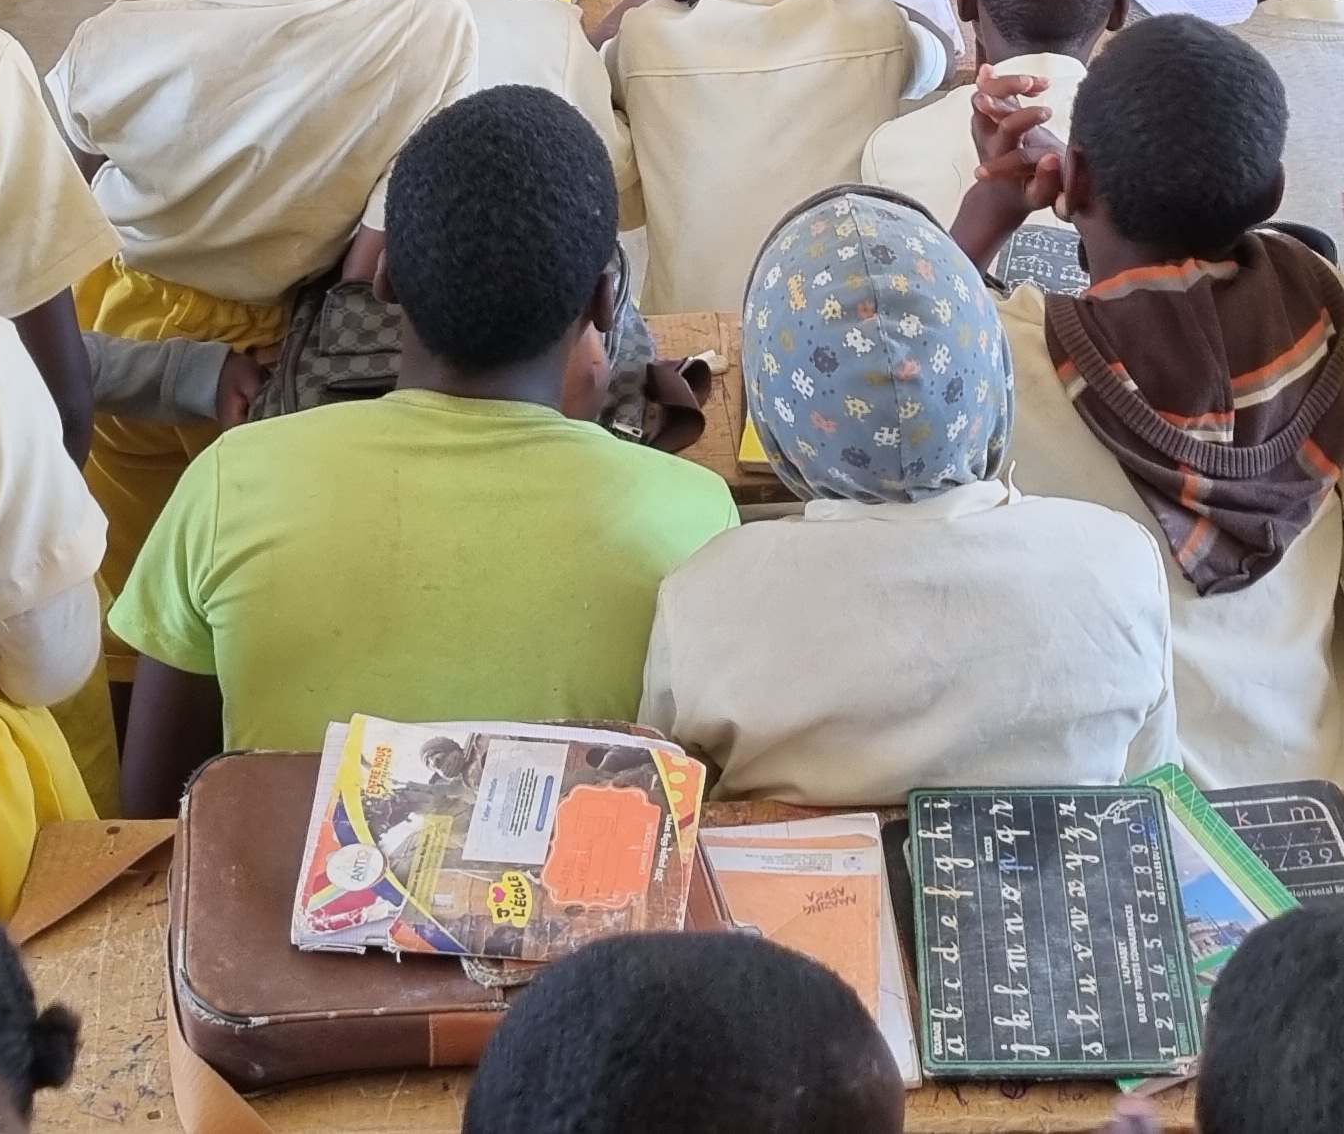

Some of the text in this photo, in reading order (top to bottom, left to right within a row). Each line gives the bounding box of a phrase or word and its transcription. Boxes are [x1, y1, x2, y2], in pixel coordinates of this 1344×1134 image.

[366, 745, 393, 796] ENTRE NOUS
[1132, 845, 1149, 855] 9
[1134, 866, 1152, 874] 8
[507, 874, 528, 918] L'ÉCOLE
[1139, 912, 1158, 923] 6
[1124, 904, 1140, 962] CONNAISSANCES
[1144, 937, 1162, 948] 5
[1148, 964, 1166, 976] 4
[1152, 992, 1170, 1002] 3
[1156, 1016, 1174, 1029] 2
[1158, 1045, 1177, 1056] 1
